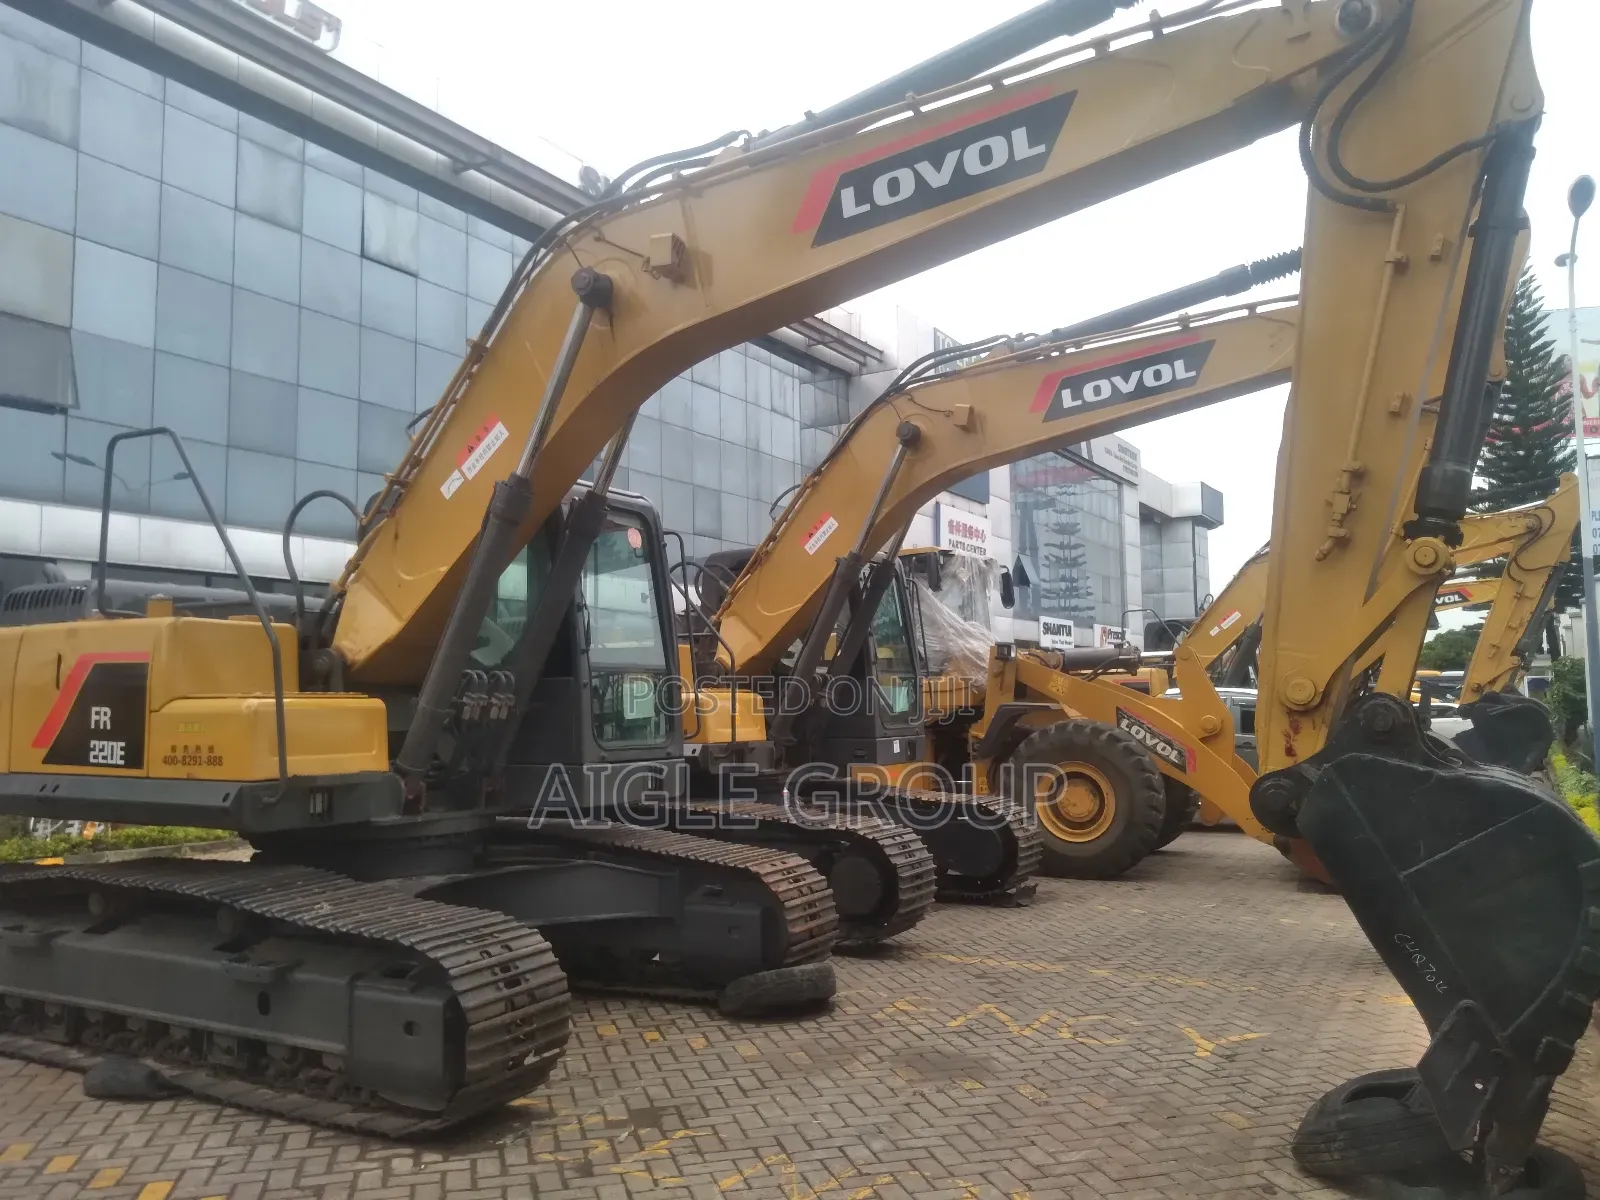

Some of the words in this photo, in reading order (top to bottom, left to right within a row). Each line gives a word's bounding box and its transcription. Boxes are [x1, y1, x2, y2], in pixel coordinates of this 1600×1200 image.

[840, 126, 1046, 219] LOVOL
[1061, 358, 1197, 409] LOVOL
[948, 538, 965, 551] PARTS
[966, 543, 986, 556] CENTER
[1042, 621, 1072, 638] SHANTUI
[91, 706, 112, 730] FR
[1119, 718, 1181, 764] LOVOL
[162, 754, 224, 767] 400-8291-888
